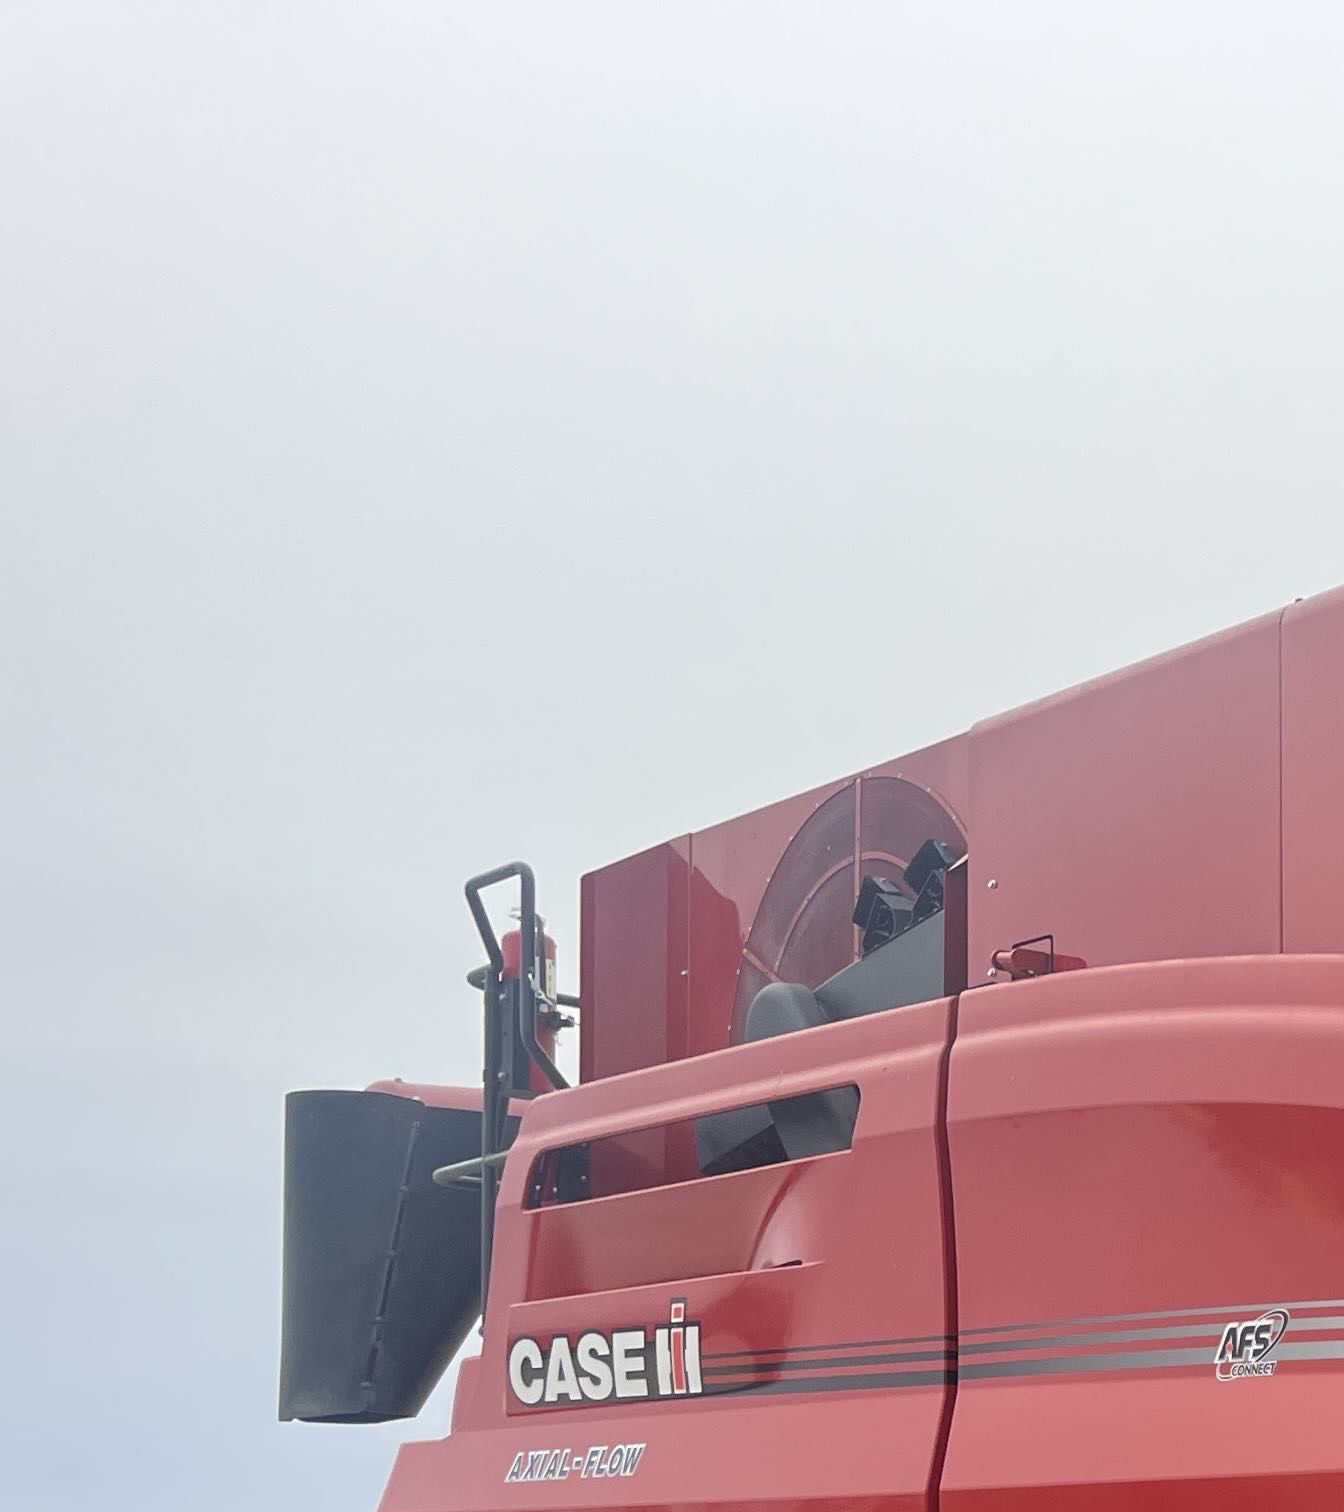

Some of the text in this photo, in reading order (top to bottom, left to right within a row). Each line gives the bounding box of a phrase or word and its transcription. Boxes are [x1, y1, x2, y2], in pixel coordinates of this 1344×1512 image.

[508, 330, 649, 405] CASE
[1214, 1319, 1275, 1363] AFS
[1231, 1361, 1277, 1377] CONNECT
[504, 1443, 646, 1483] AXIAL-FLOW
